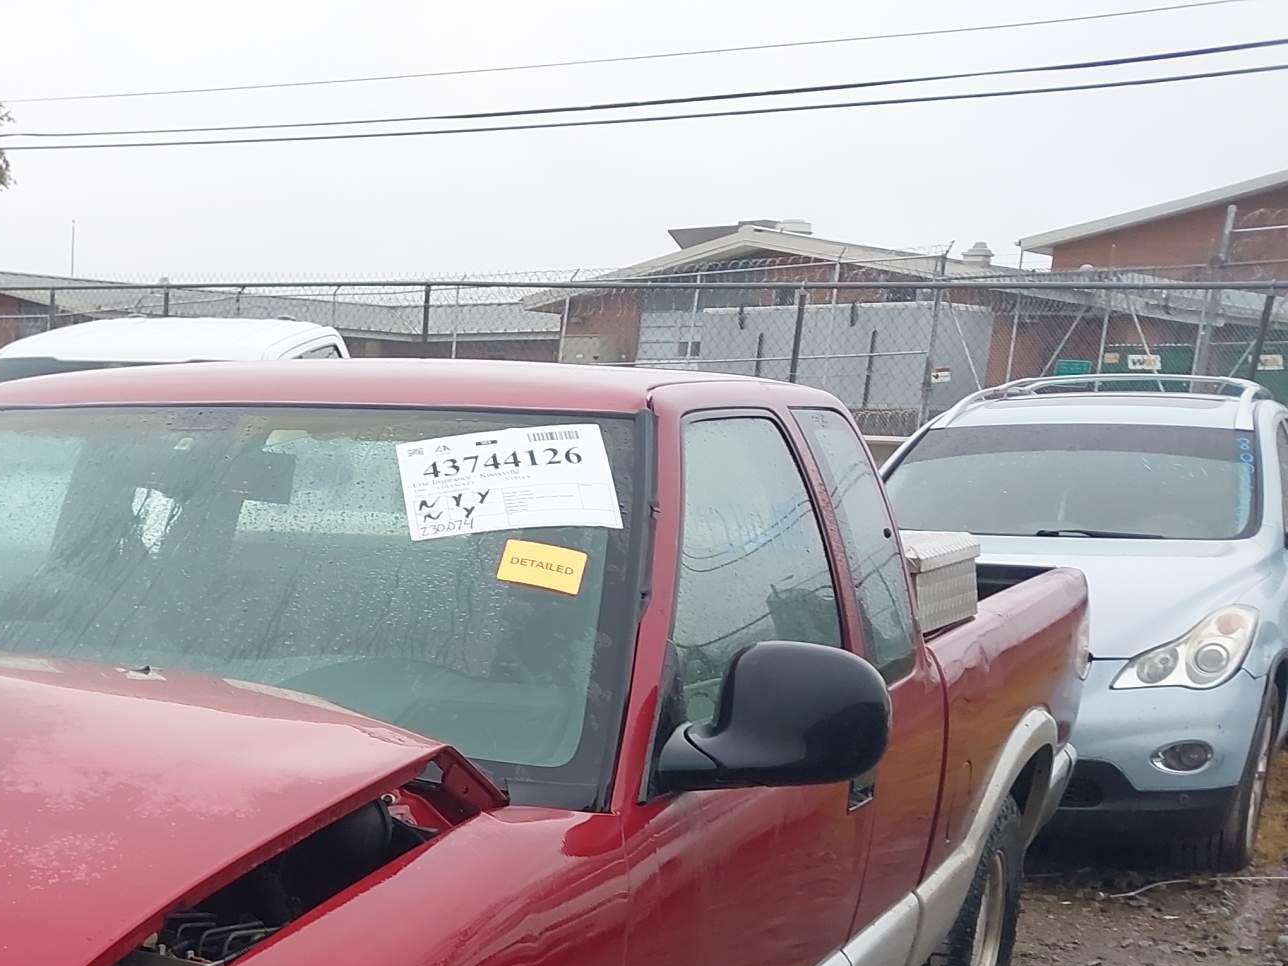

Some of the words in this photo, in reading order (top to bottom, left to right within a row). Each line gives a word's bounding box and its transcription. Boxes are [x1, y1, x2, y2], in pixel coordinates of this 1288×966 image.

[423, 447, 583, 478] 43744126
[478, 489, 490, 504] Y
[509, 556, 574, 576] DETAILED
